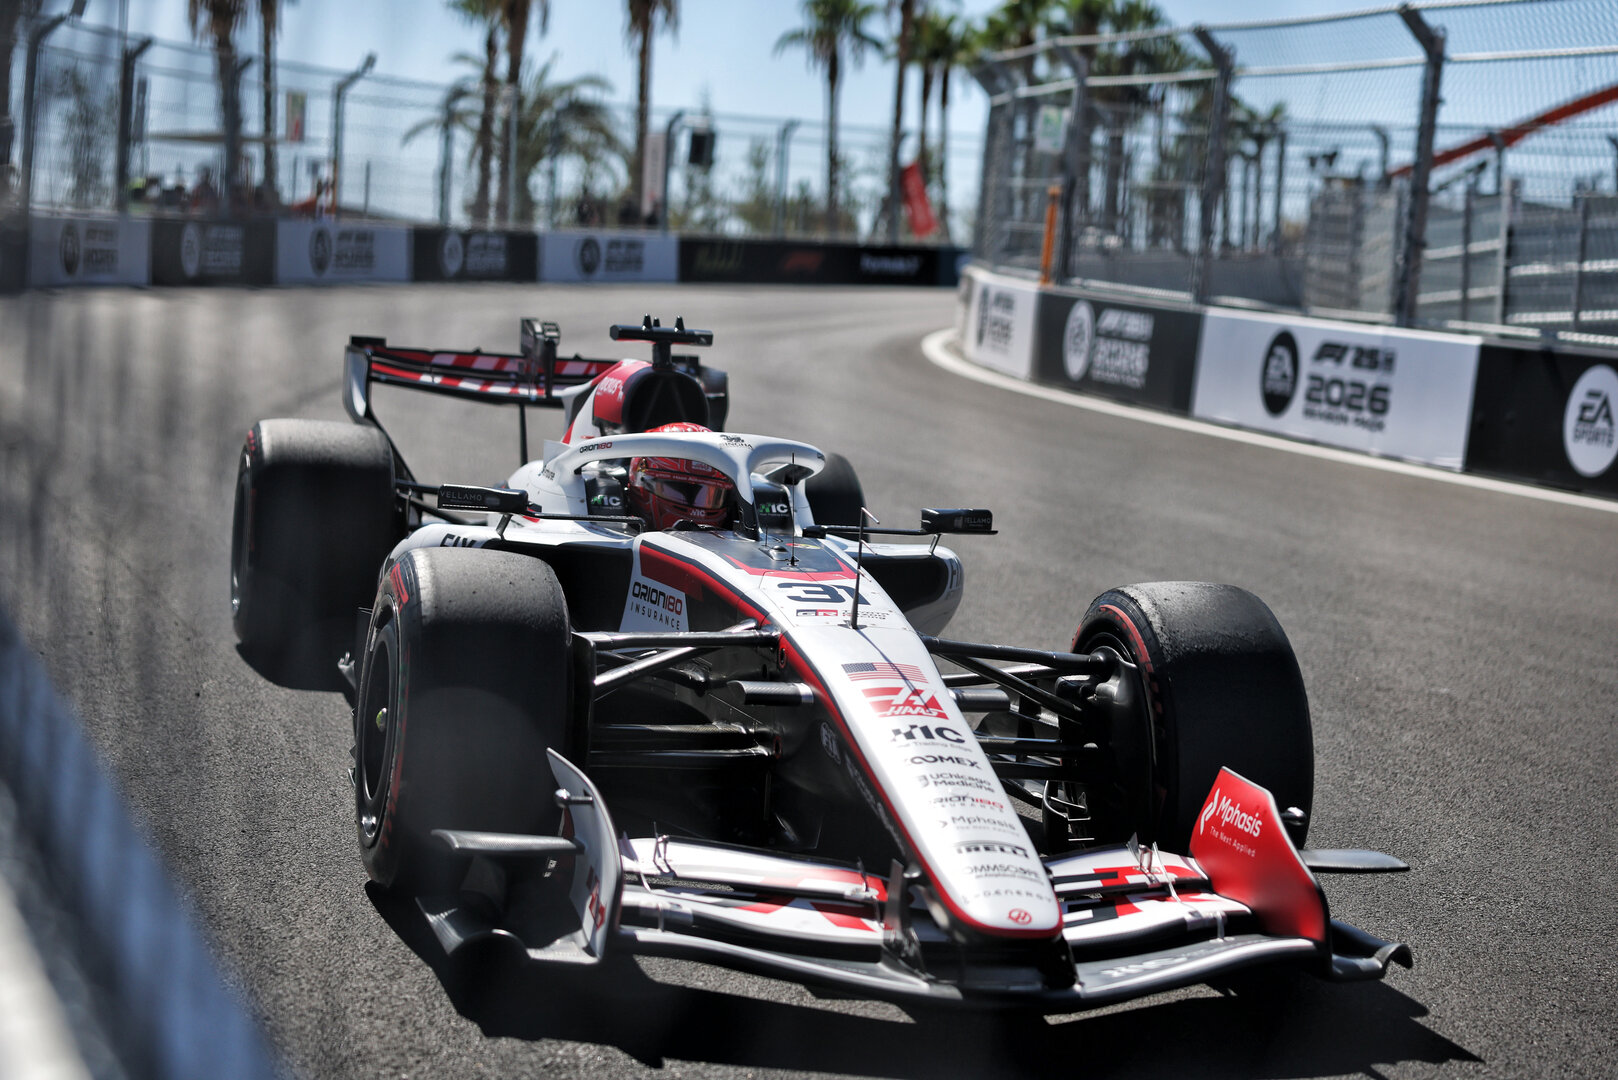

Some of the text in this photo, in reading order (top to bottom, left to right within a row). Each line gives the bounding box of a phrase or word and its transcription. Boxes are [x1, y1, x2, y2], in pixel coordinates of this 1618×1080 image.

[1305, 374, 1390, 417] 2026
[1578, 389, 1615, 426] EA
[1573, 423, 1616, 449] SPORTS
[440, 490, 483, 502] VELLAMO
[632, 581, 683, 616] ORION180
[777, 582, 872, 606] 31
[630, 601, 680, 631] INSURANCE
[886, 705, 939, 716] HAAS
[932, 780, 996, 794] Medicine
[951, 816, 1016, 830] Mphasis
[1216, 795, 1262, 837] Mphasis
[1210, 826, 1256, 856] The Next Applied
